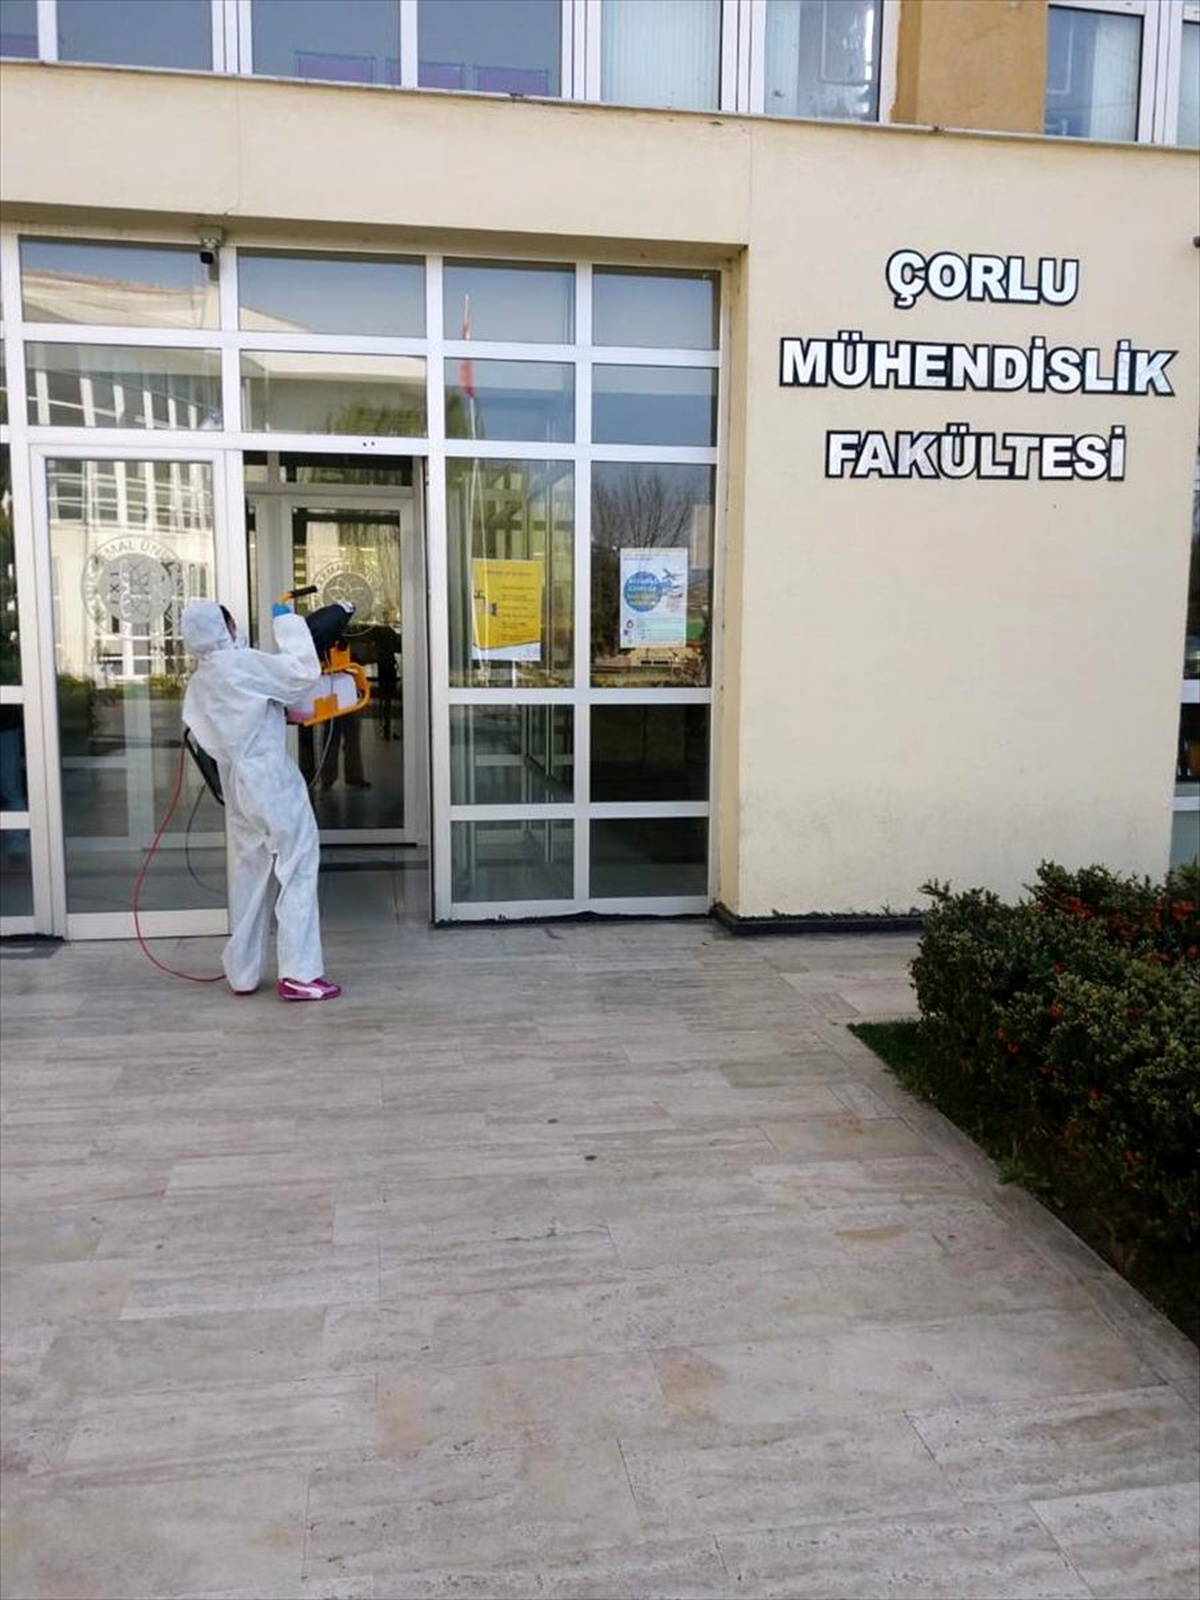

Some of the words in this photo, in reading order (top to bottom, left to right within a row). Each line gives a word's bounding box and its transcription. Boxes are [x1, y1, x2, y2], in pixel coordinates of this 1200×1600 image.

[886, 249, 1080, 309] ÇORLU
[780, 330, 1179, 397] MÜHENDİSLİK
[825, 422, 1126, 482] FAKÜLTESİ
